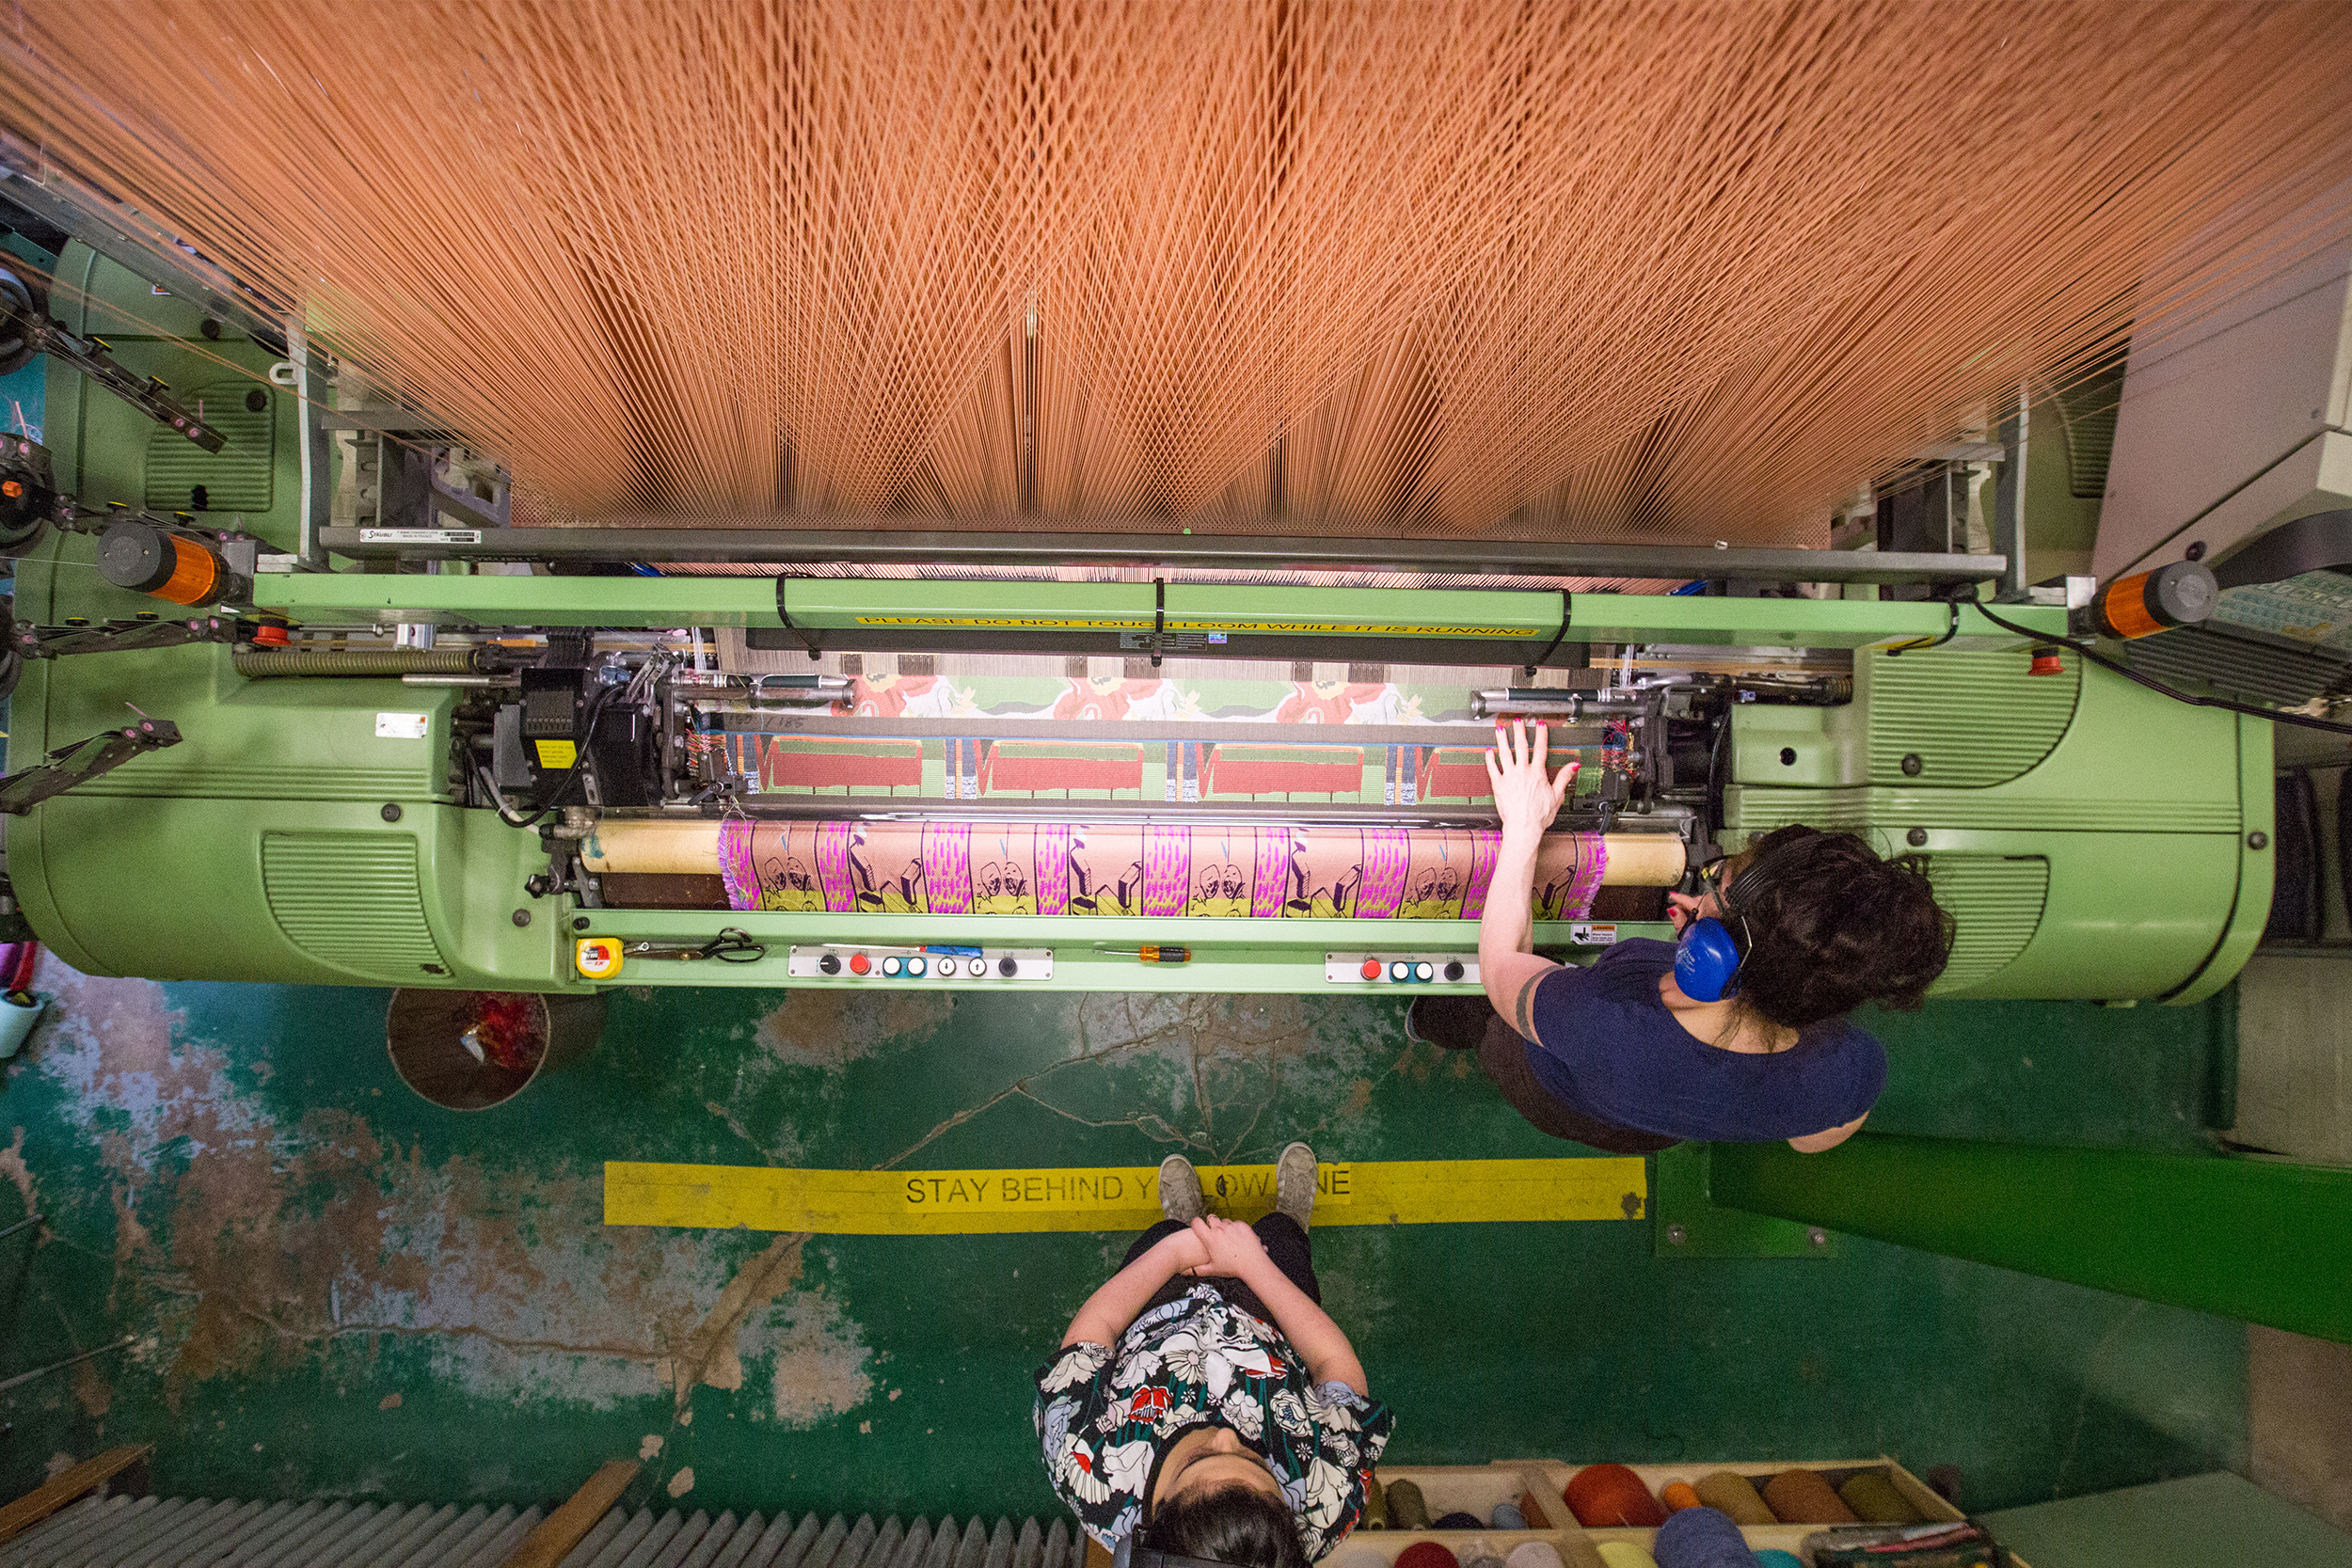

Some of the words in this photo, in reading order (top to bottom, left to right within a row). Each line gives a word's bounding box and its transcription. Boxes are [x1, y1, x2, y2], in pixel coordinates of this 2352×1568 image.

[906, 1178, 988, 1203] STAY
[1002, 1177, 1123, 1202] BEHIND
[1135, 1172, 1270, 1199] YOW
